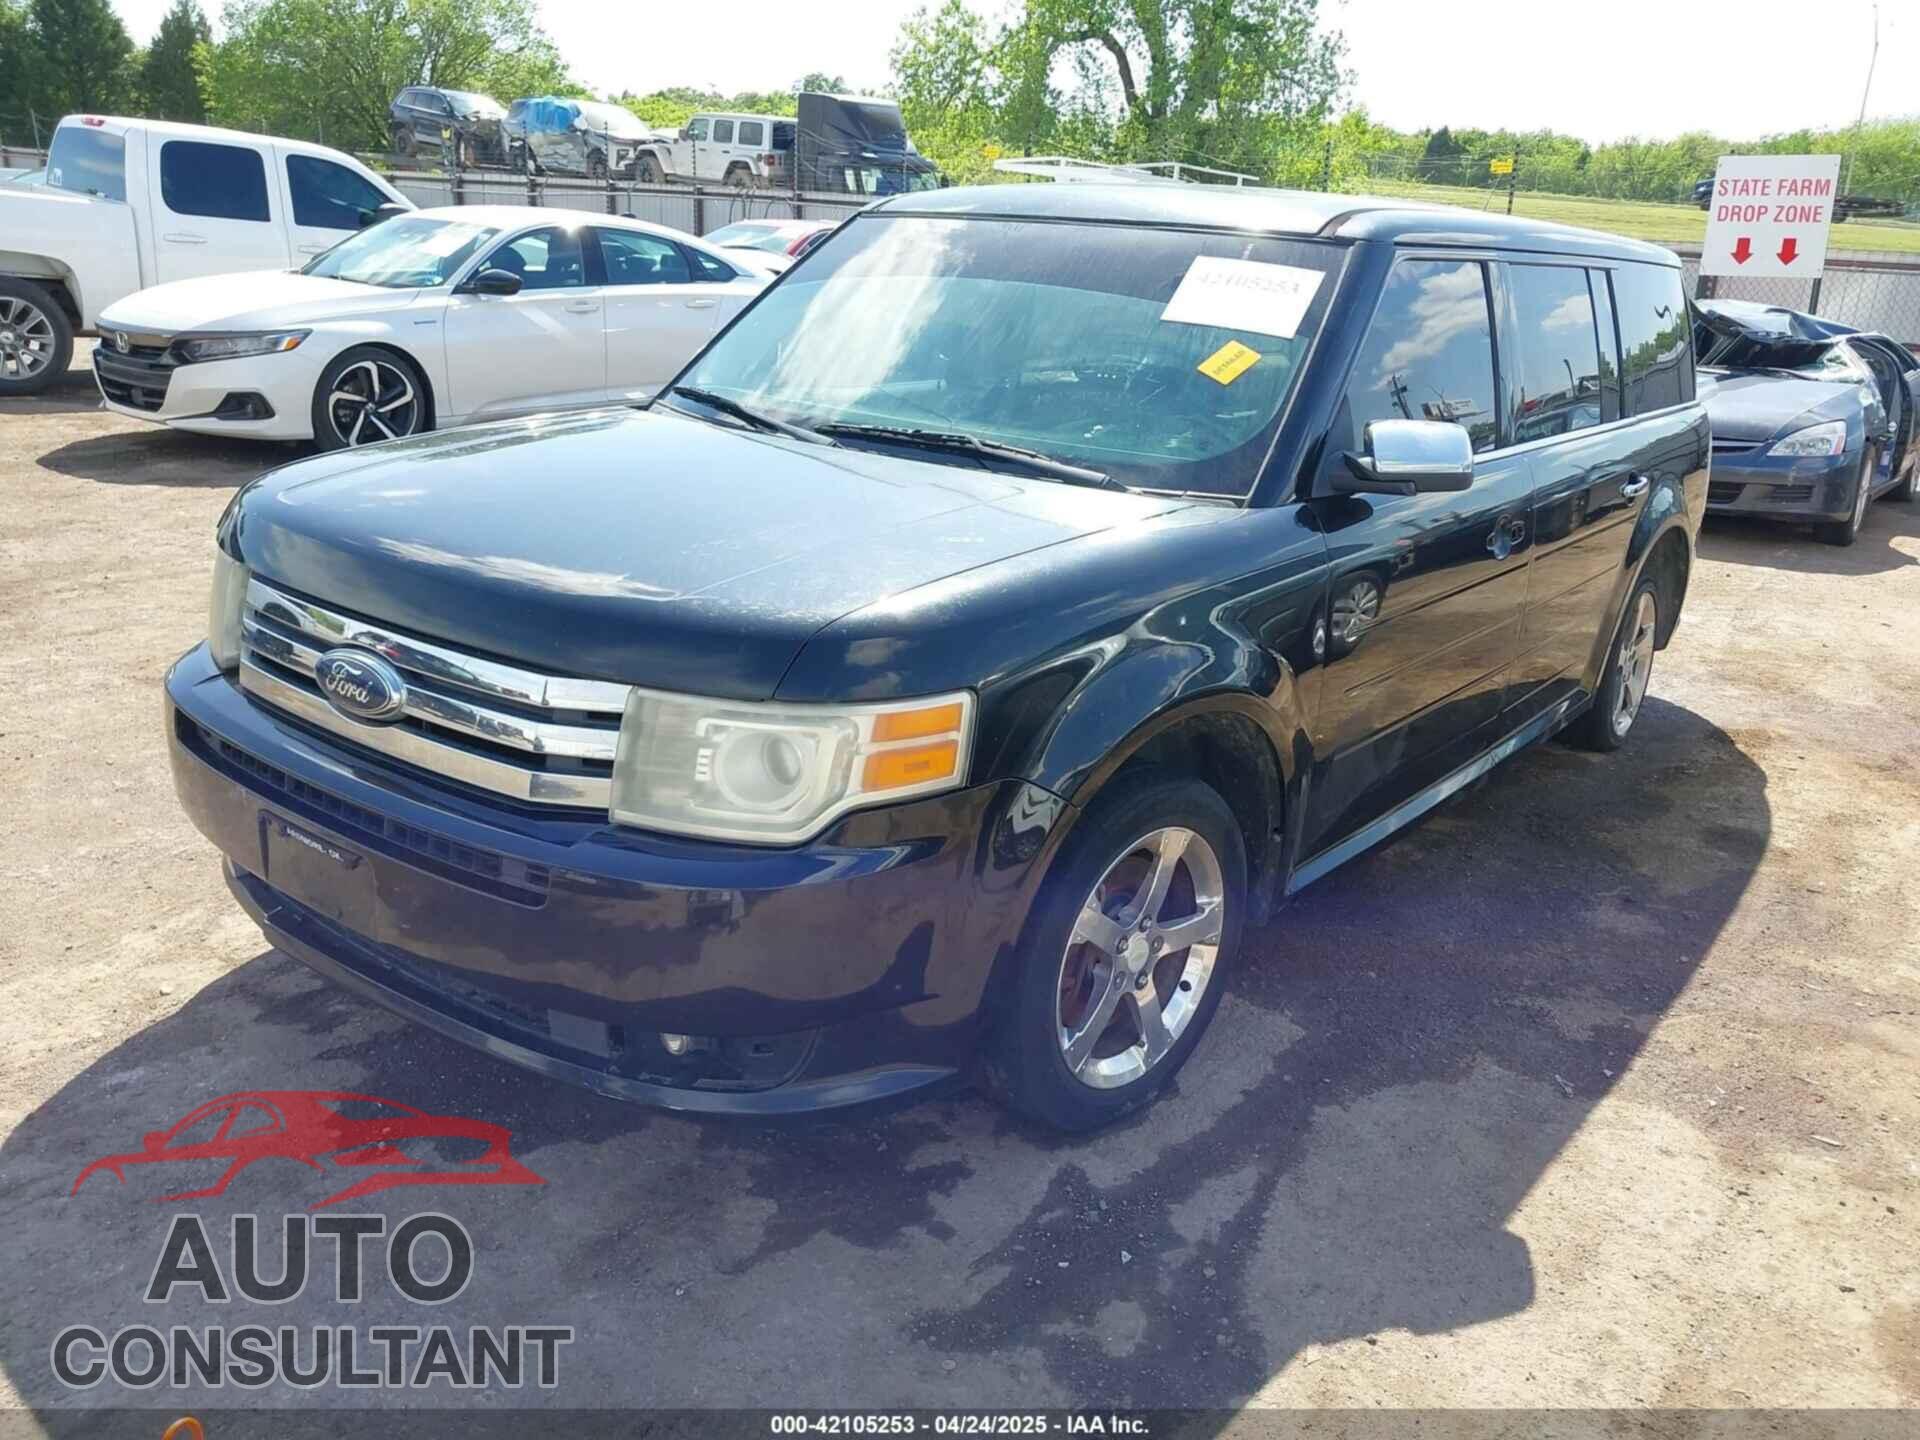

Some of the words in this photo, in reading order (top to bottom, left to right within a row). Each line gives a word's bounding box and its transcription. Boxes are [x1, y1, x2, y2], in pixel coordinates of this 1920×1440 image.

[1718, 178, 1772, 197] STATE
[1776, 178, 1831, 197] FARM
[1716, 204, 1768, 223] DROP
[1773, 204, 1824, 223] ZONE
[326, 661, 373, 703] Ford
